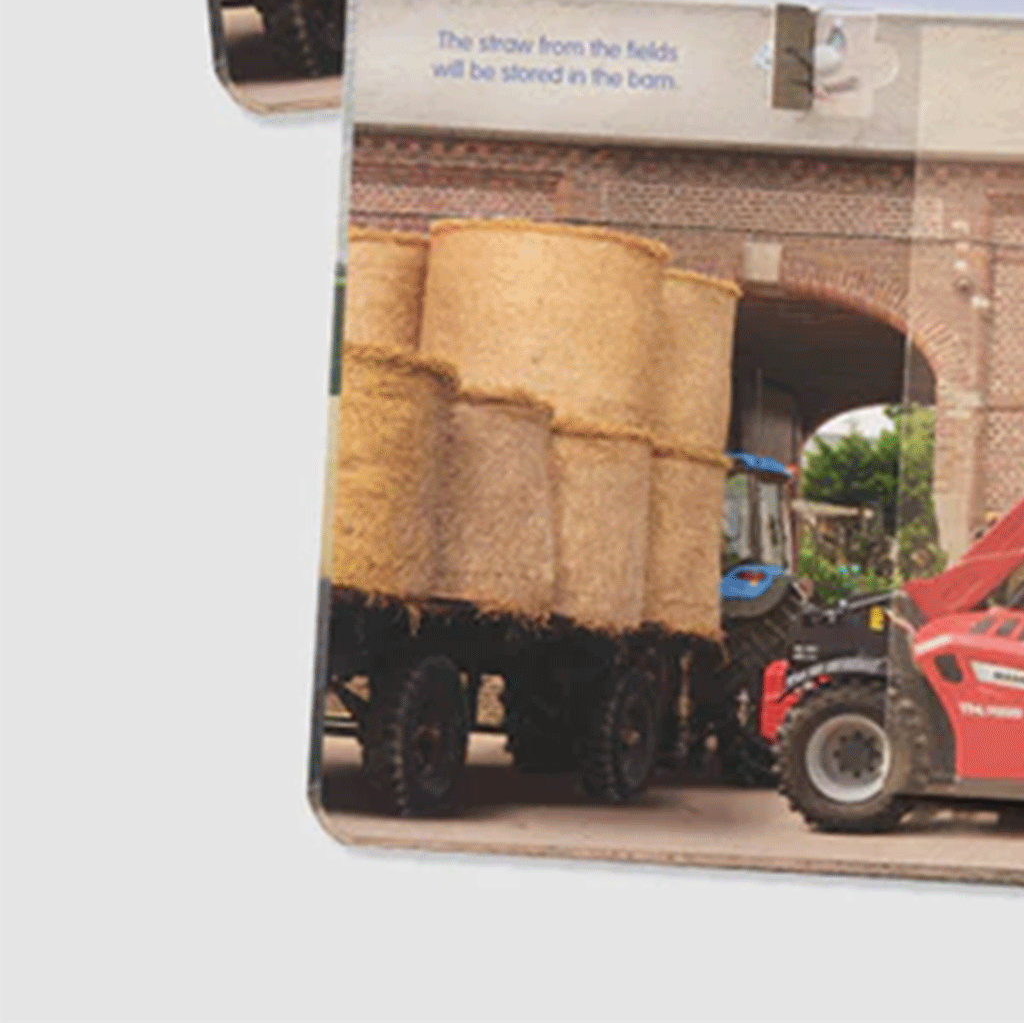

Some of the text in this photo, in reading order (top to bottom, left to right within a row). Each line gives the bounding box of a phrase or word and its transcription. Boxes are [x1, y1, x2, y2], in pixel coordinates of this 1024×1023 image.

[438, 29, 678, 62] The straw from the fields
[431, 59, 682, 90] will be stored in the barn.
